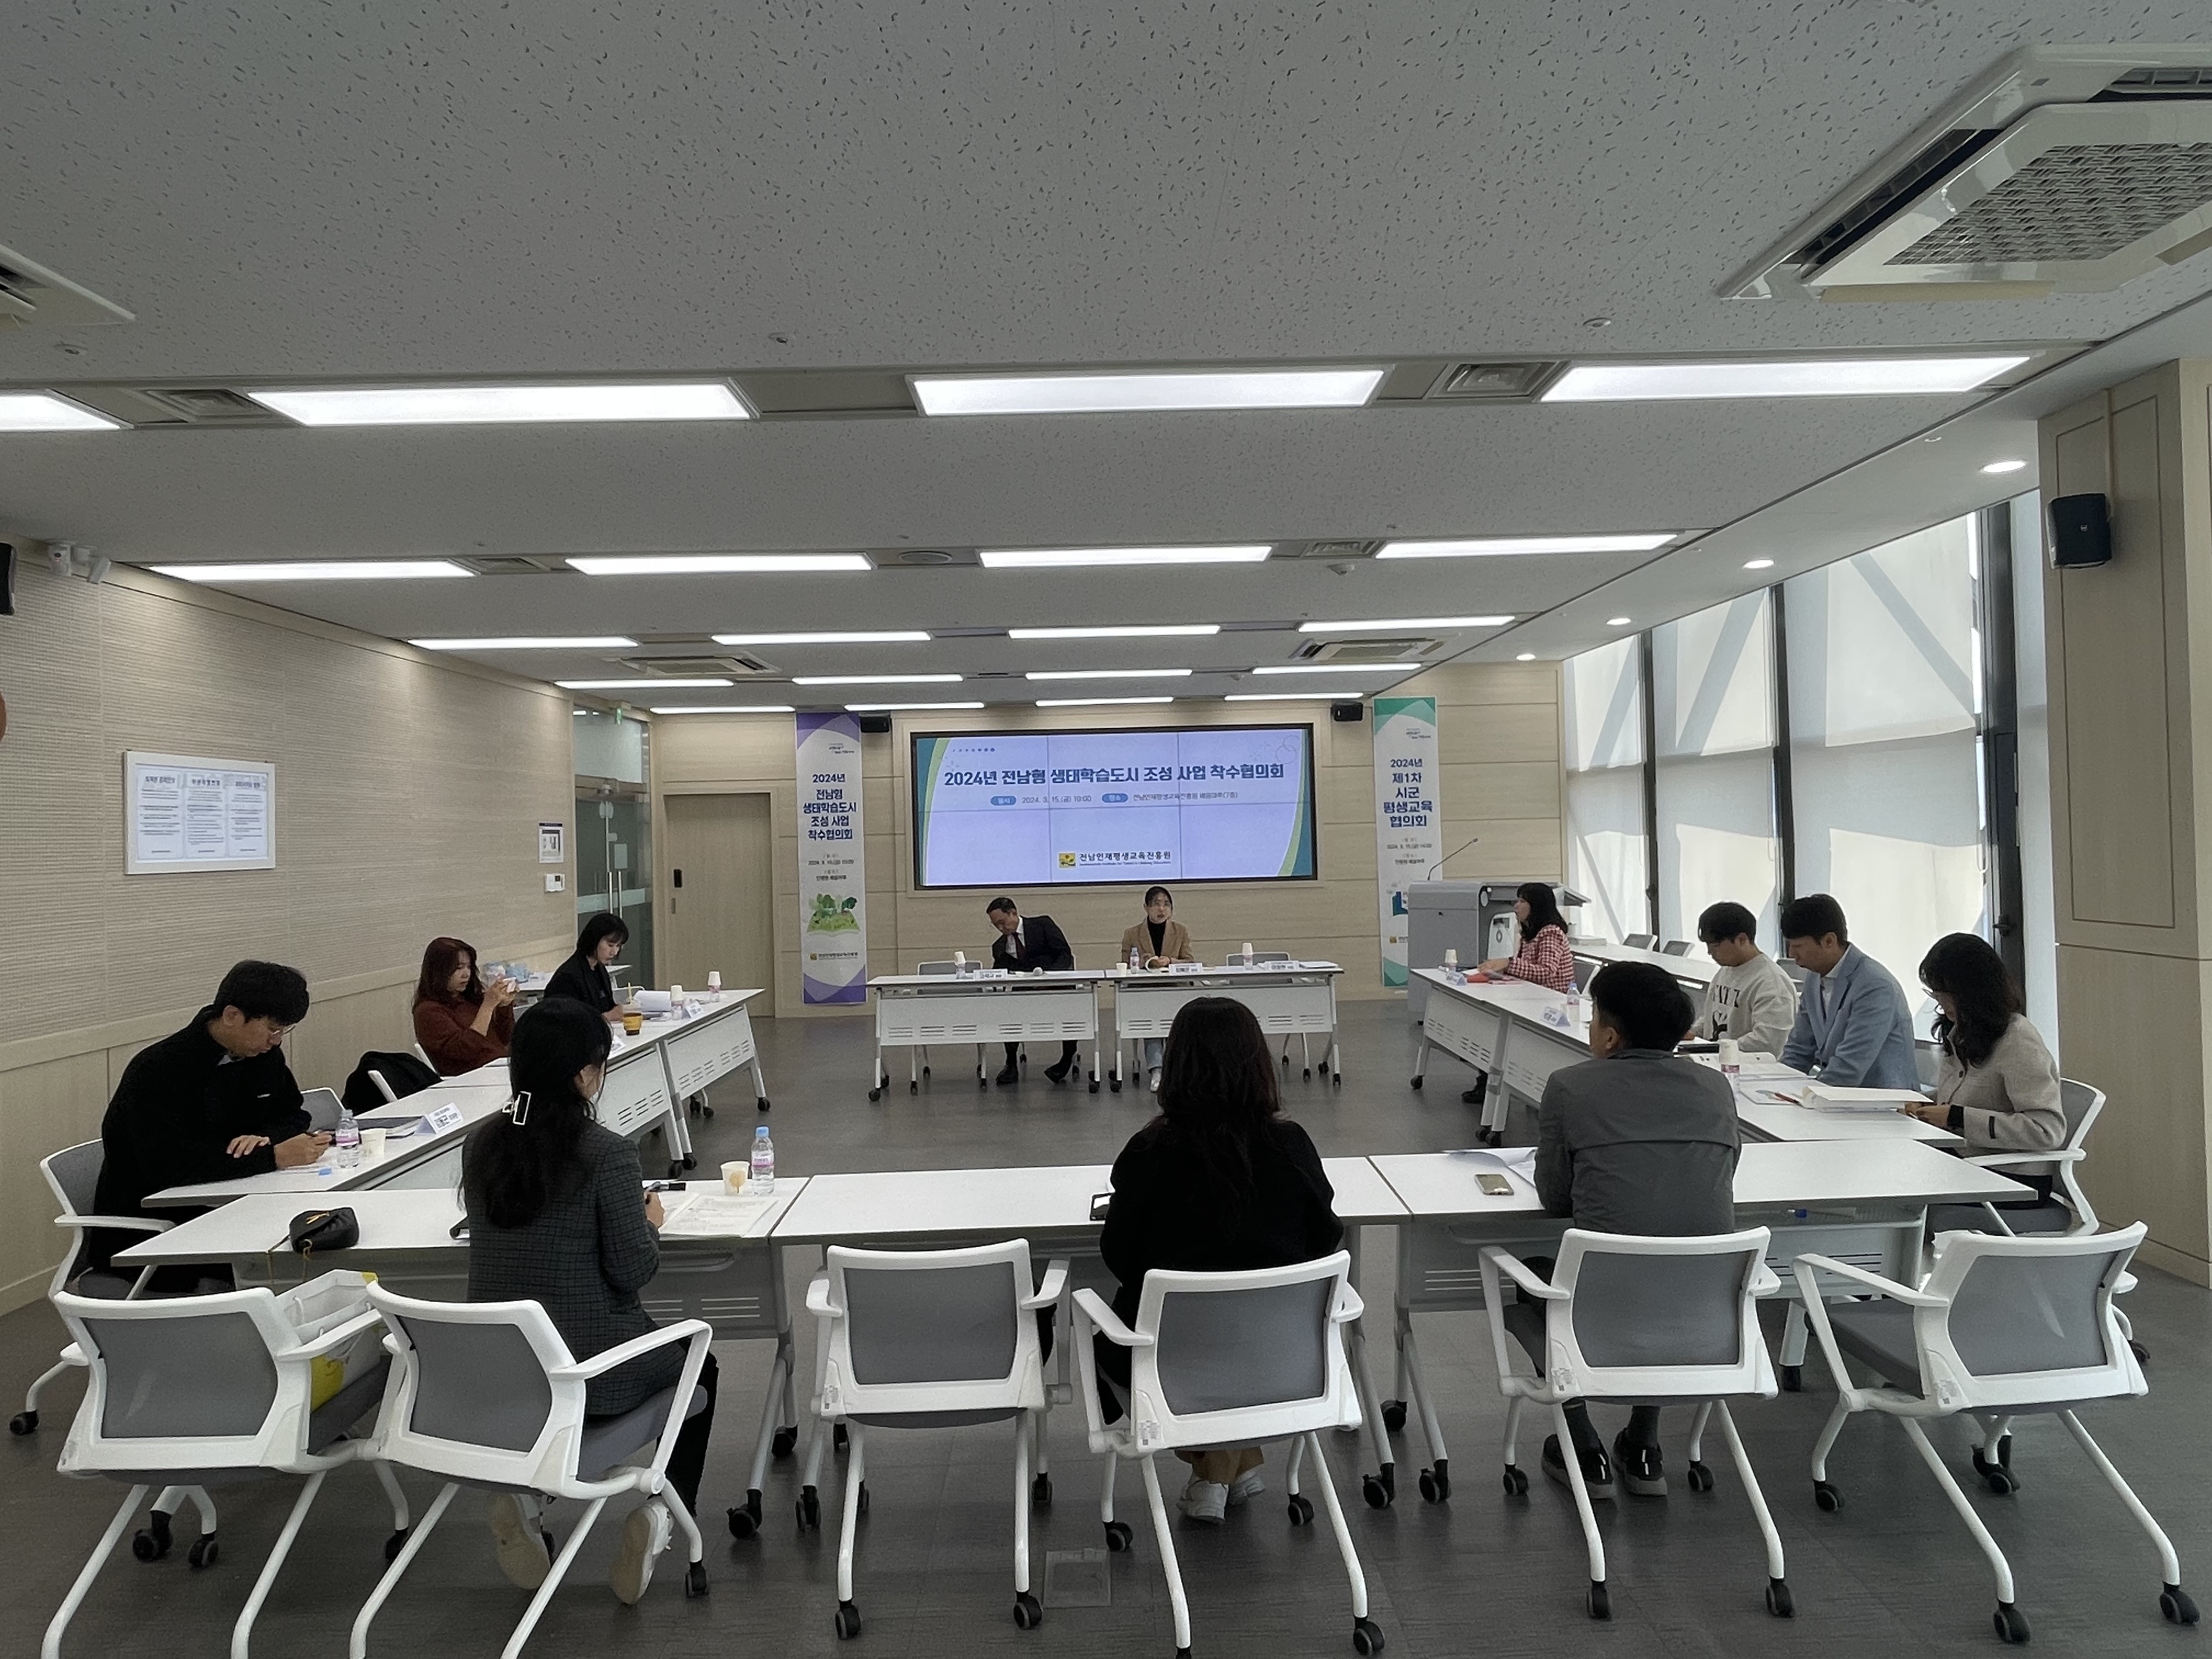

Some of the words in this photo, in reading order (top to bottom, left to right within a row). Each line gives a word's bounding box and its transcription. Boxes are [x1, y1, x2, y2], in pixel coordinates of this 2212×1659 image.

[1390, 758, 1423, 768] 2024년
[812, 774, 845, 783] 2024년
[944, 770, 997, 786] 2024년
[1002, 769, 1046, 785] 전남형
[1050, 767, 1139, 783] 생태학습도시
[1143, 766, 1172, 781] 조성
[1177, 765, 1206, 780] 사업
[1210, 763, 1284, 780] 착수협의회
[1392, 772, 1421, 783] 제1차
[816, 789, 843, 800] 전남형
[1395, 787, 1419, 798] 시군
[803, 802, 856, 814] 생태학습도시
[1384, 800, 1432, 814] 평생교육
[811, 816, 828, 827] 조성
[831, 815, 849, 826] 사업
[1390, 815, 1427, 827] 협의회
[808, 829, 853, 841] 착수협의회
[1079, 851, 1171, 861] 전남인재평생교육진흥원
